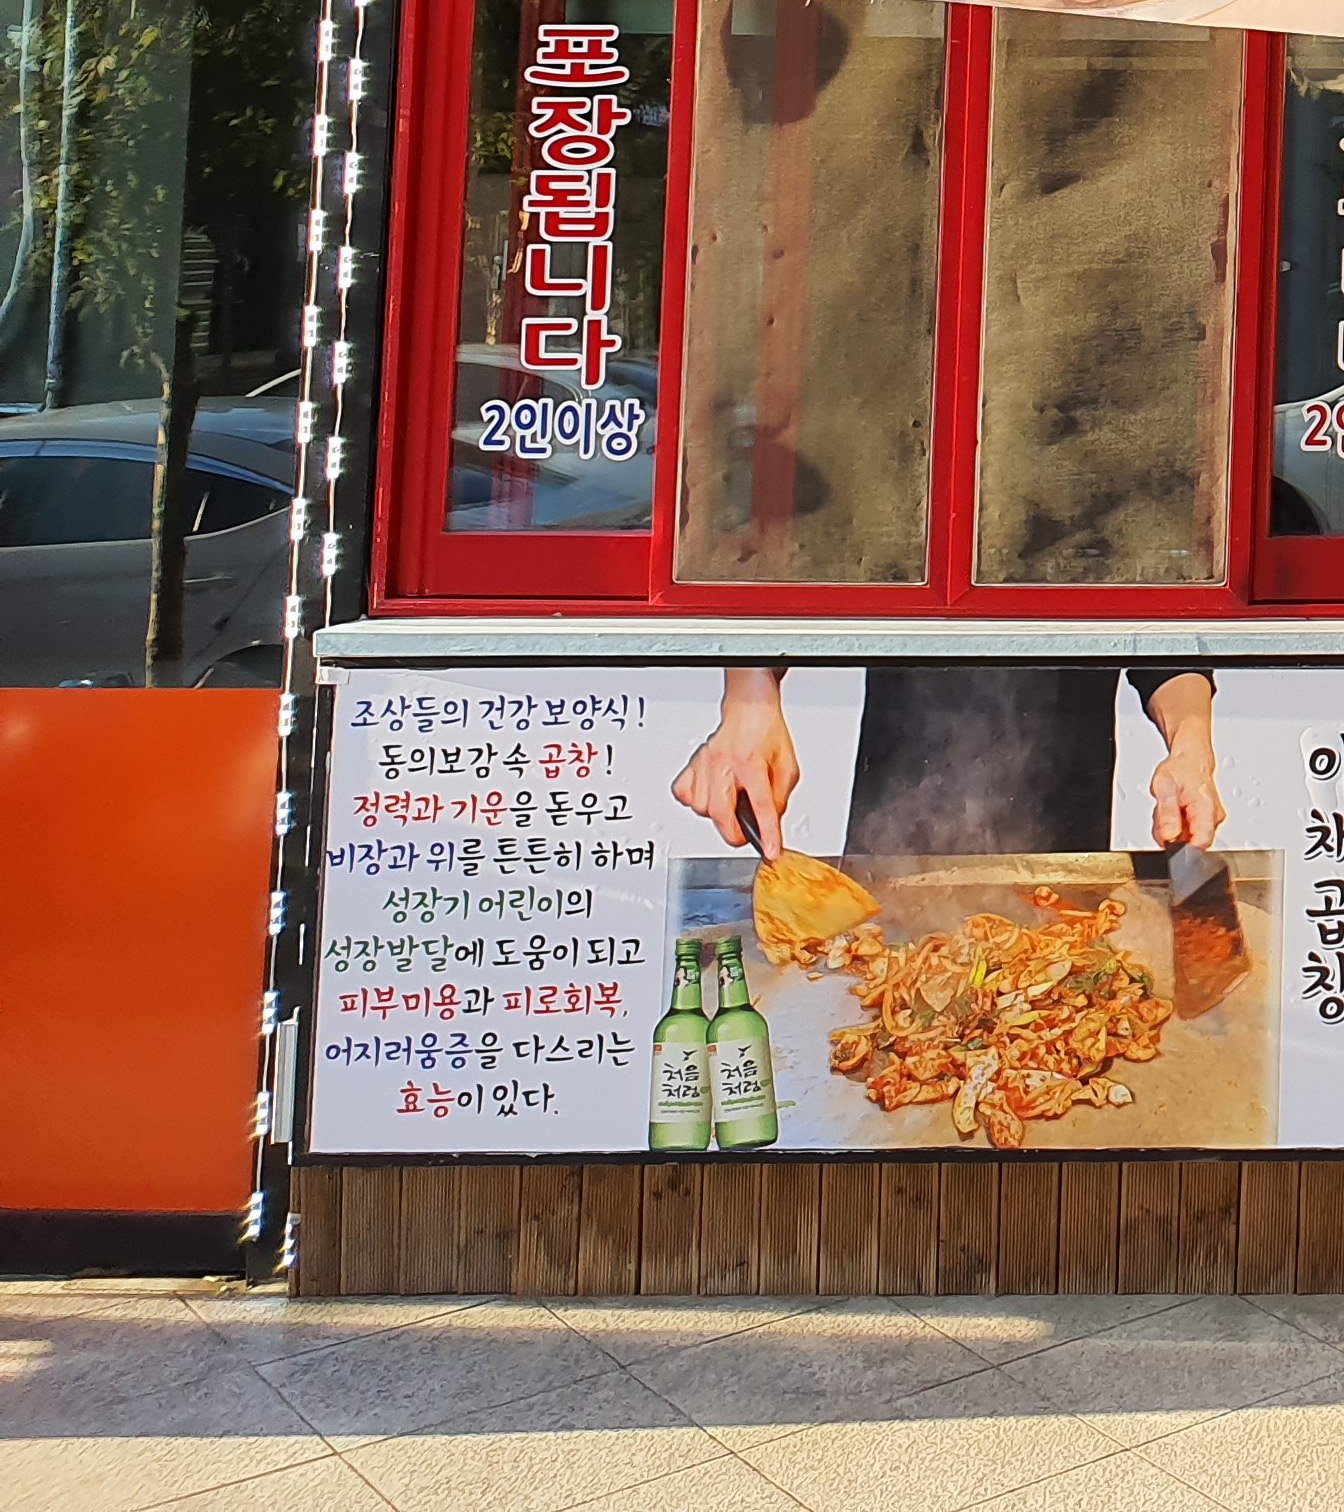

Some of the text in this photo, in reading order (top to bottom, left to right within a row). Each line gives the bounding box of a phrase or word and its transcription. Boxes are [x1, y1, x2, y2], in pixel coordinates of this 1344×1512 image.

[523, 23, 633, 391] 포장됩니다
[478, 397, 646, 462] 2인이상
[350, 695, 469, 732] 조상들의
[478, 694, 538, 731] 건강
[377, 743, 499, 780] 동의보감
[352, 790, 634, 828] 정력과 기운을 돋우고
[327, 836, 655, 877] 비장과 위를 튼튼히 하며
[381, 885, 593, 925] 성장기 어린이의
[323, 933, 646, 974] 성장발달에 도움이 되고
[338, 983, 496, 1022] 피부미용과
[324, 1030, 636, 1070] 어지러움증을 다스리는
[395, 1079, 560, 1120] 효능이 있다.
